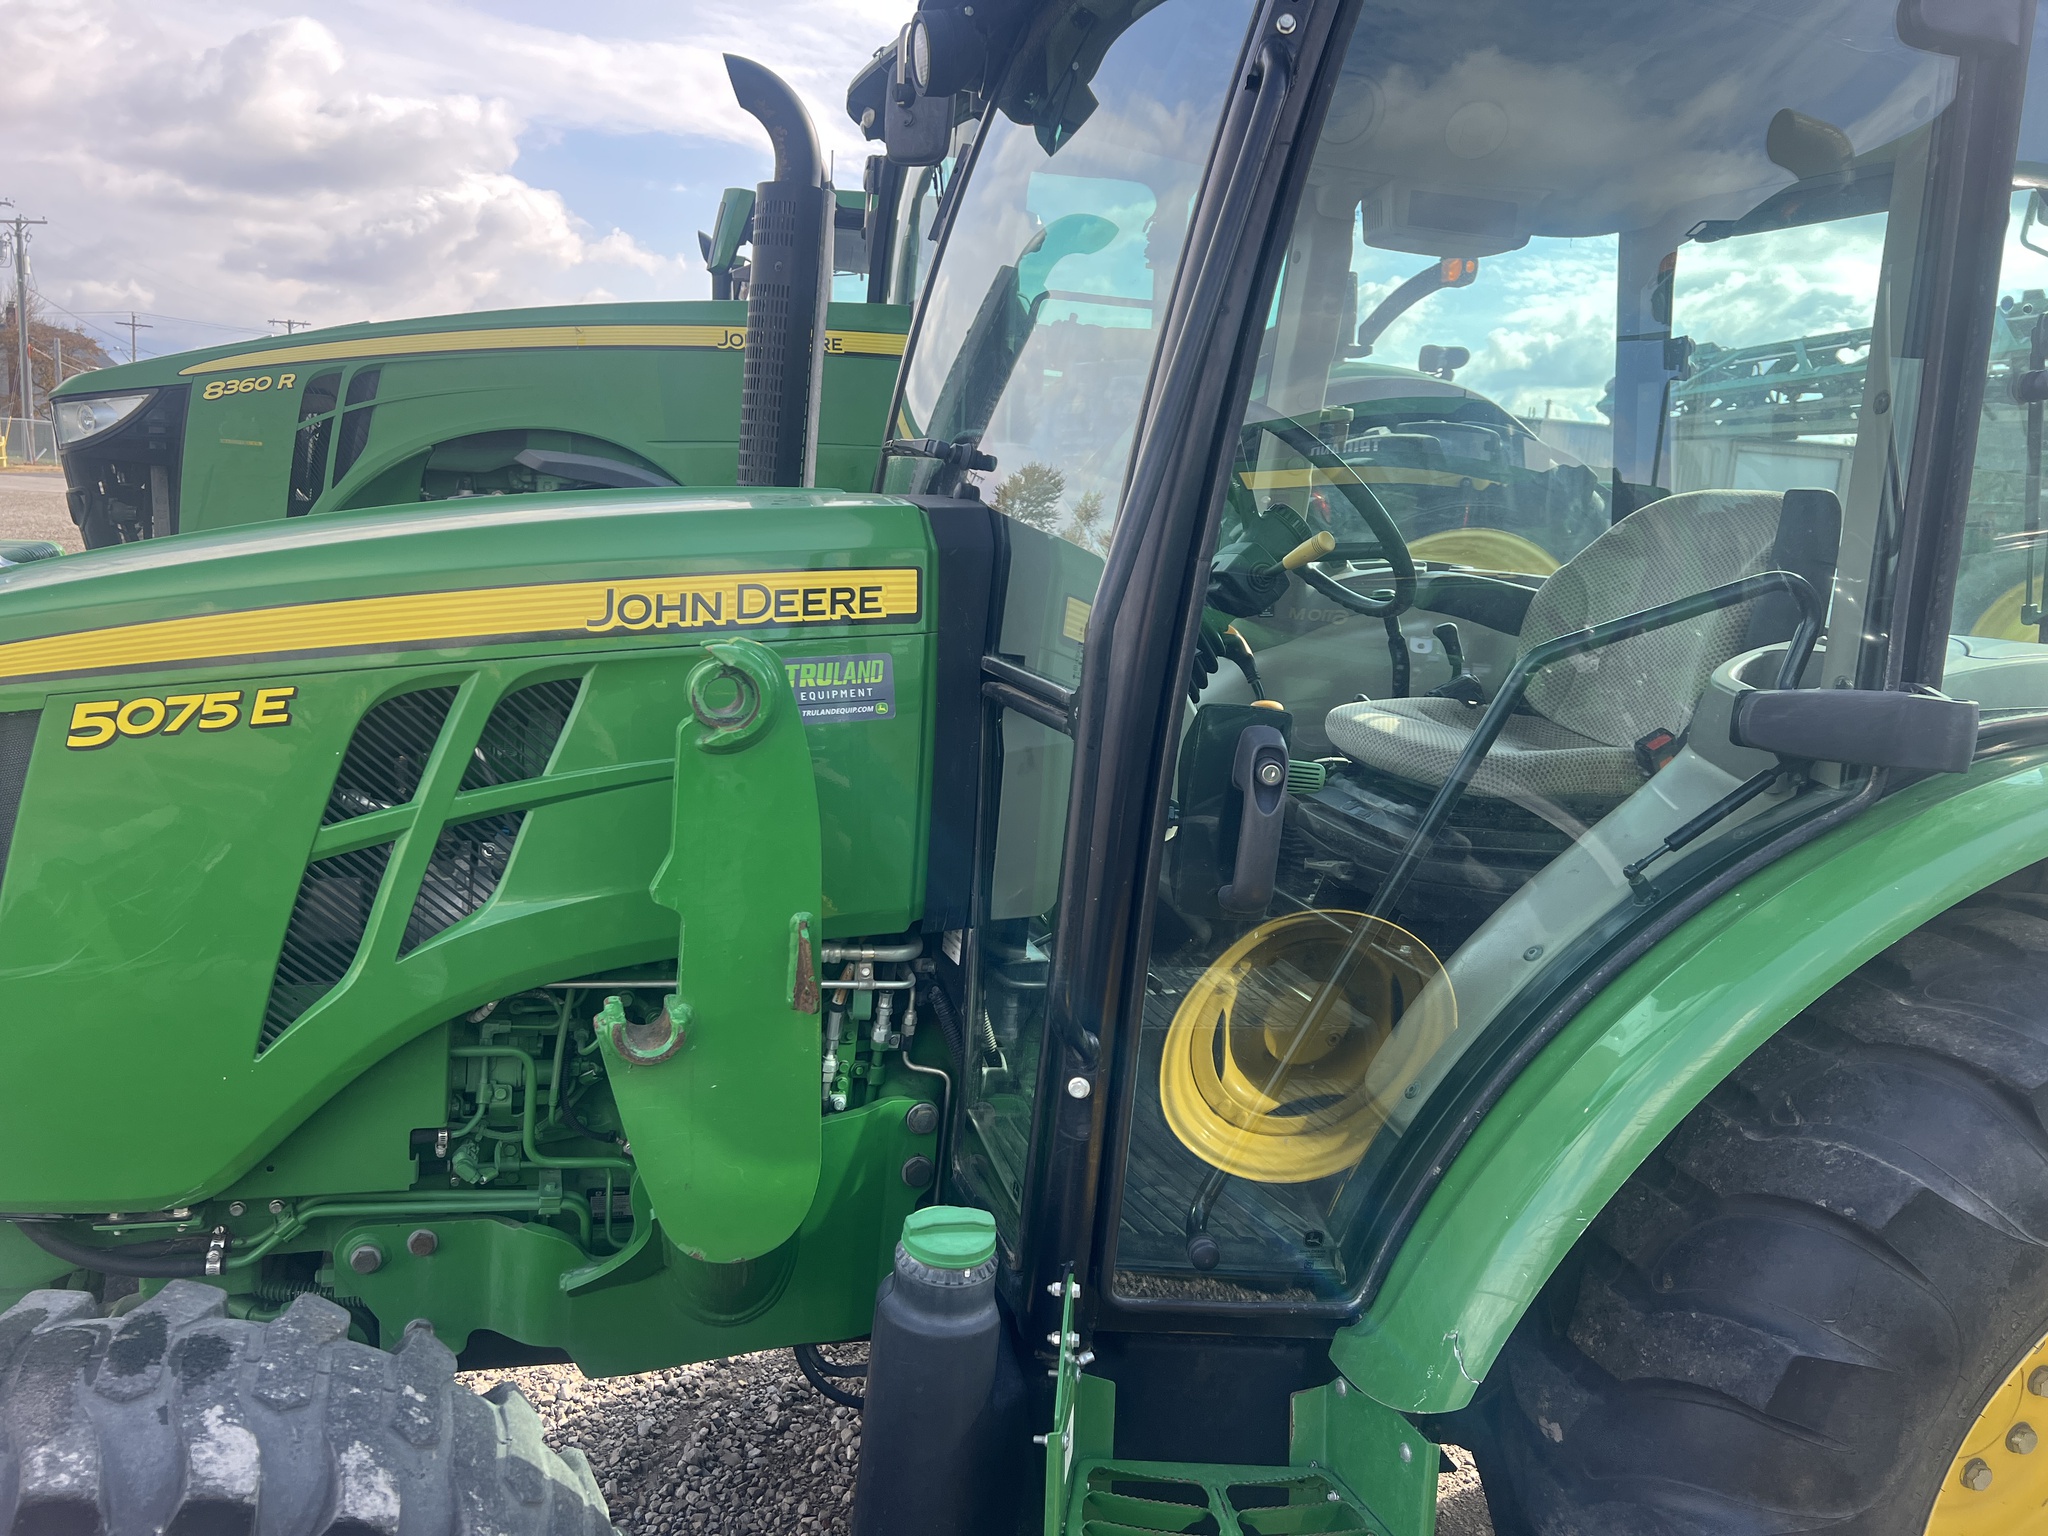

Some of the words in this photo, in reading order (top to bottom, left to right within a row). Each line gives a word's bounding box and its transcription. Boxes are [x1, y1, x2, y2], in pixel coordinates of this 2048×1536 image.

[203, 375, 273, 401] 8360
[277, 373, 297, 390] R
[586, 588, 724, 628] JOHN
[736, 583, 884, 621] DEERE
[785, 660, 885, 688] TRULAND
[800, 688, 873, 701] EQUIPMENT
[65, 690, 245, 751] 5075
[249, 685, 298, 729] E
[802, 705, 874, 717] TRULANDEQUIP.COM
